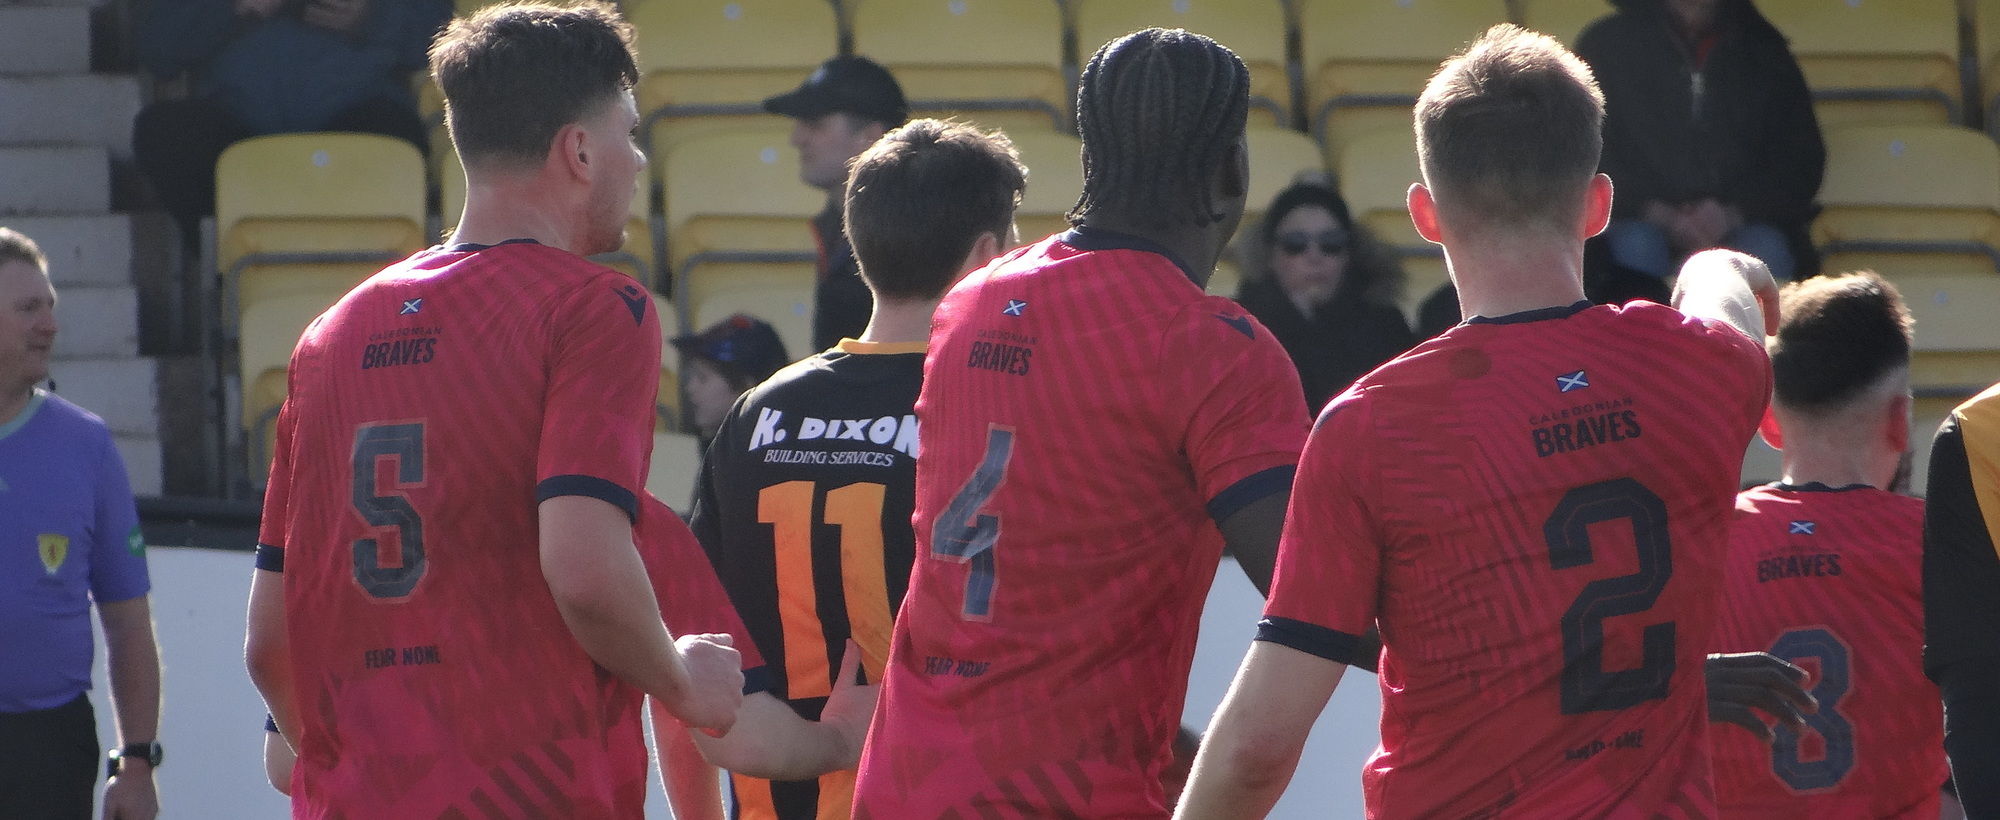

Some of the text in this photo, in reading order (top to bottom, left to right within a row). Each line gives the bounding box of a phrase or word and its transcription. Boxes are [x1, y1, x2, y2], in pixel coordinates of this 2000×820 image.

[362, 338, 437, 369] BRAVES
[967, 341, 1032, 376] BRAVES
[749, 407, 920, 459] K. DIXON
[1529, 397, 1633, 425] CALEDONIAN
[1532, 410, 1642, 457] BRAVES
[764, 450, 894, 467] BUILDING SERVICES
[352, 422, 426, 602] 5
[932, 423, 1016, 623] 4
[757, 481, 895, 700] 11
[1757, 553, 1842, 582] BRAVES
[1543, 477, 1676, 716] 2
[1767, 625, 1856, 793] 8
